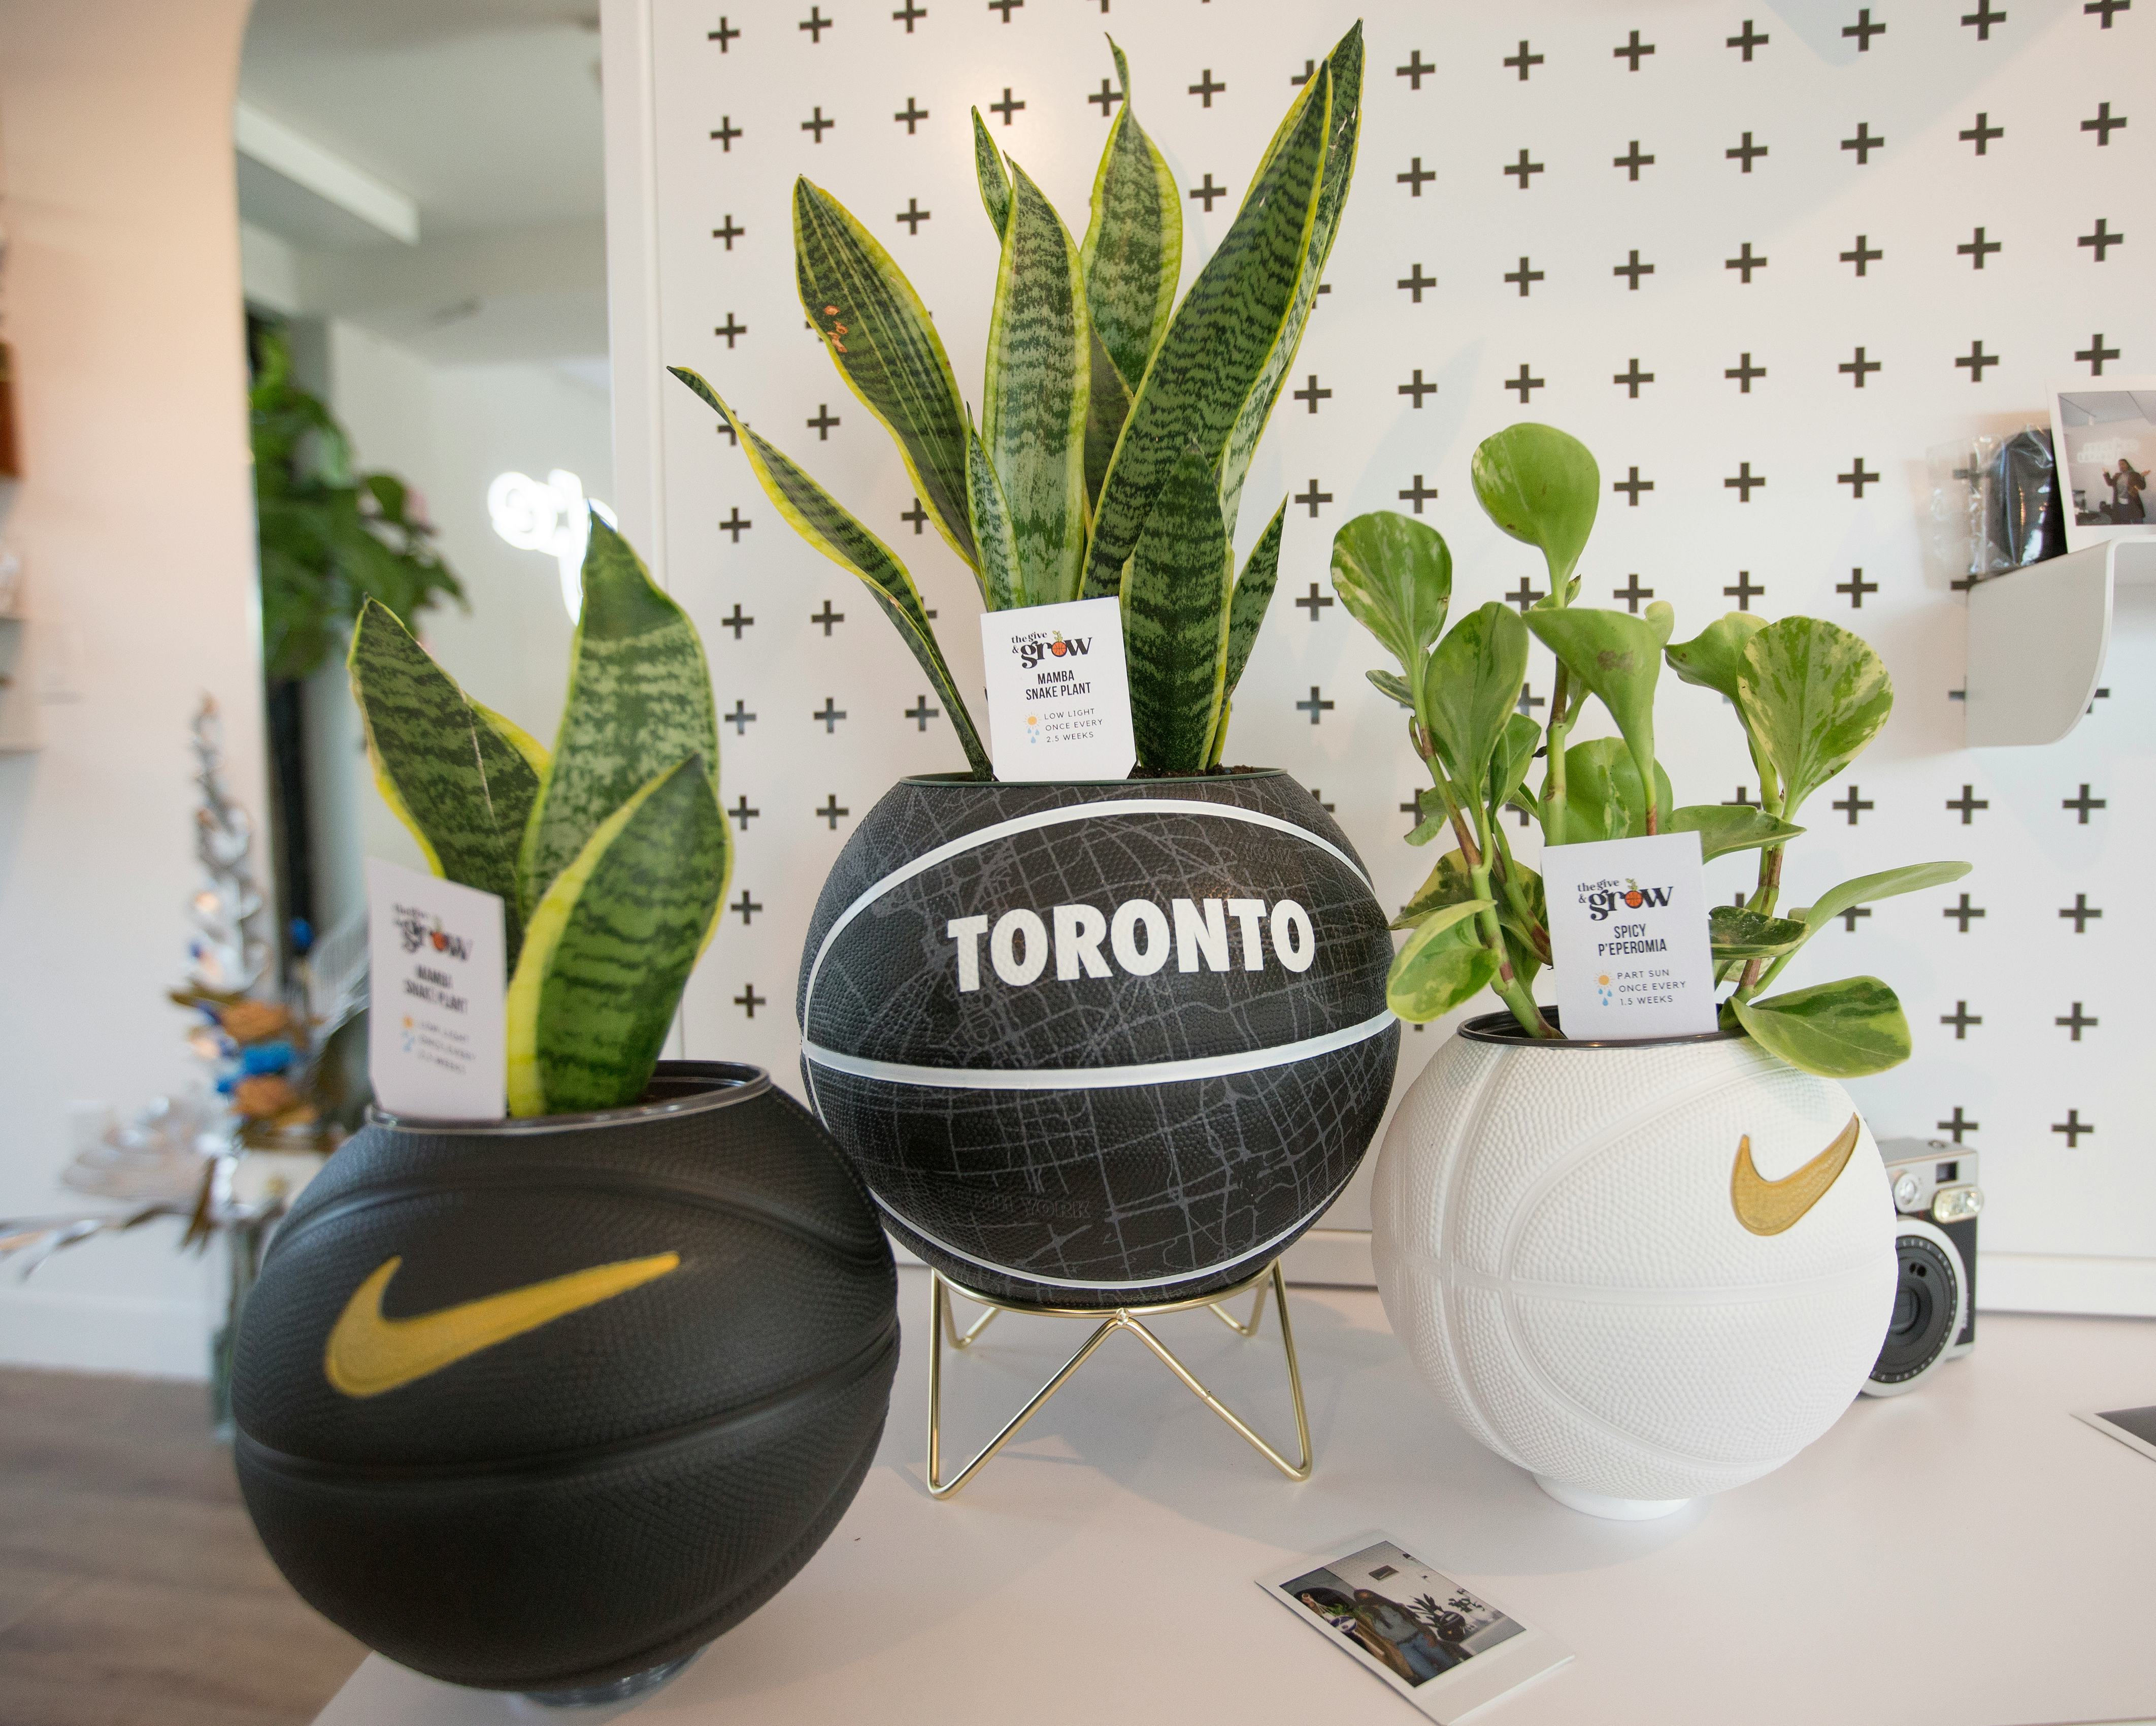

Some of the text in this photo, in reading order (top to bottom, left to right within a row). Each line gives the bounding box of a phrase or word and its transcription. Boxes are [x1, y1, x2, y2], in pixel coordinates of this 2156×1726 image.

[1011, 631, 1048, 644] the give
[1012, 645, 1019, 654] &
[1037, 669, 1075, 685] MAMBA
[1025, 681, 1091, 700] SNAKE PLANT
[1044, 708, 1095, 720] LOW LIGHT
[1045, 719, 1103, 731] ONCE EVERY
[1046, 731, 1094, 743] 2.5 WEEKS
[1577, 878, 1620, 892] the give
[1578, 894, 1587, 904] &
[1614, 923, 1646, 939] SPICY
[947, 897, 1315, 992] TORONTO
[1598, 938, 1668, 957] P'EPEROMIA
[1617, 969, 1670, 980] PART SUN
[1618, 981, 1686, 993] ONCE EVERY
[1620, 995, 1674, 1006] 1.5 WEEKS
[1019, 1196, 1092, 1219] YORK
